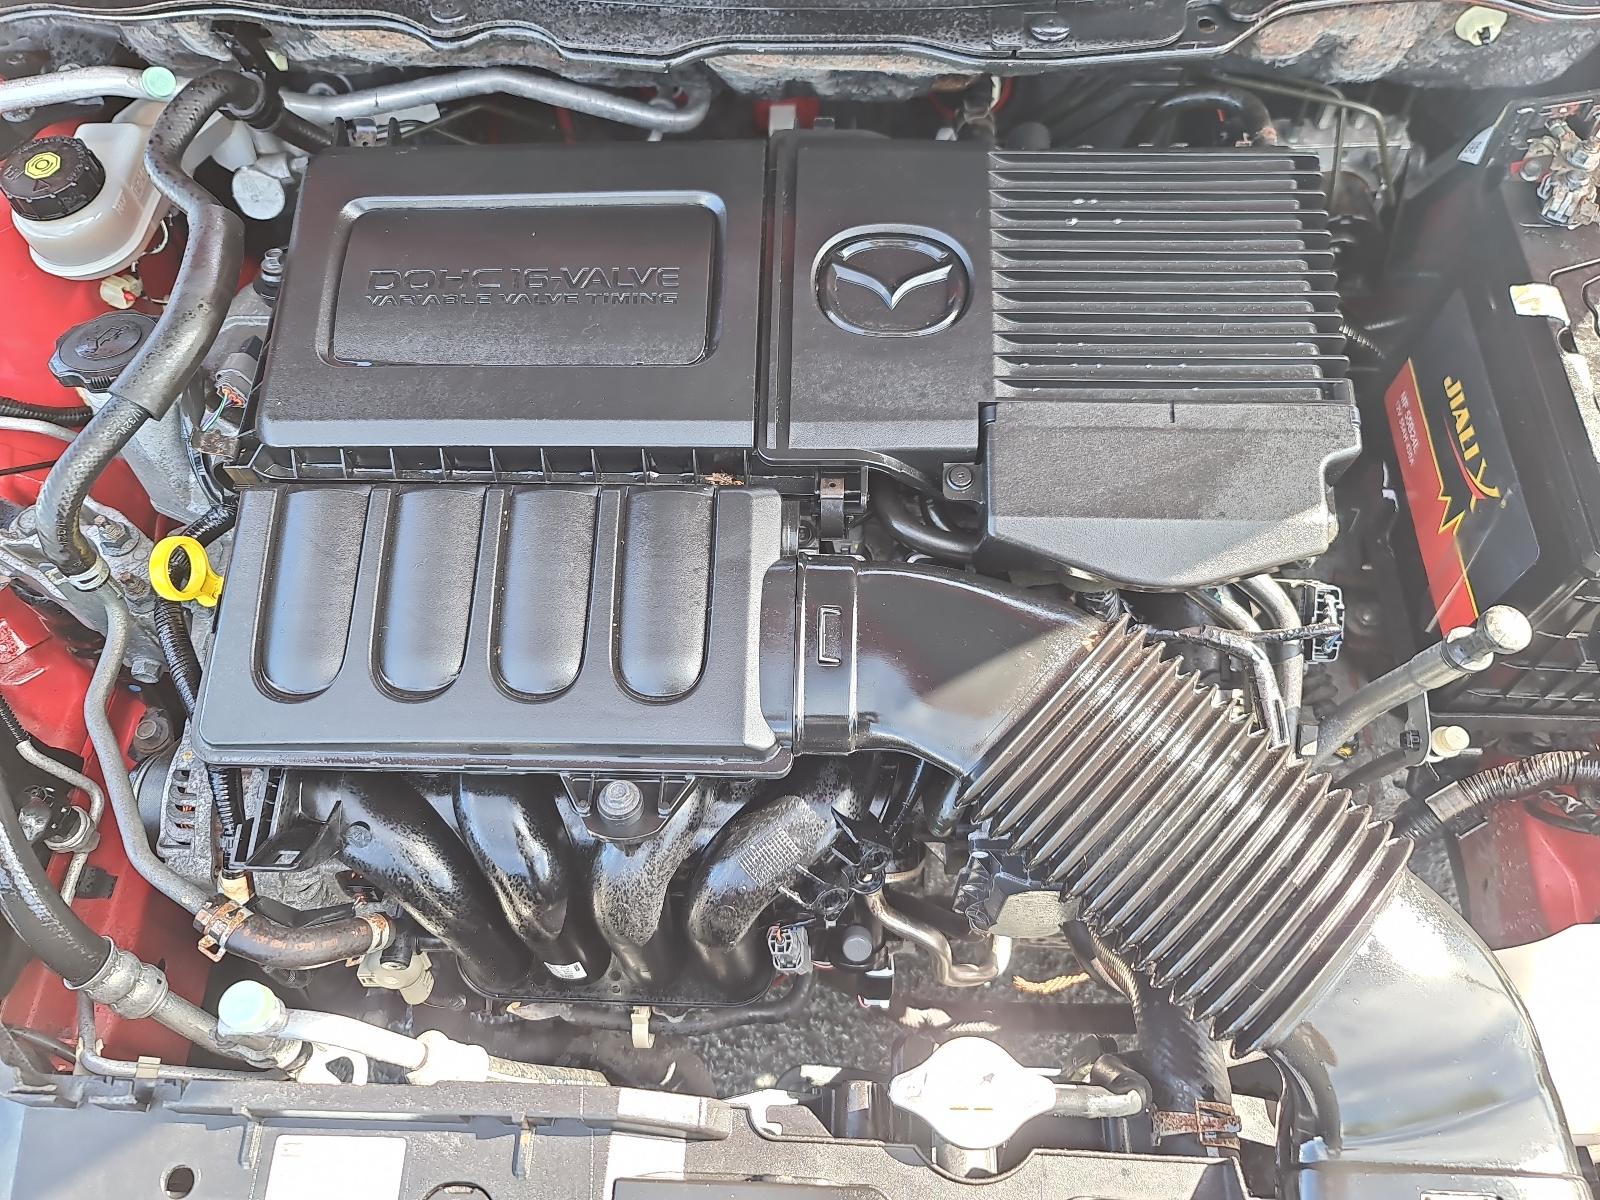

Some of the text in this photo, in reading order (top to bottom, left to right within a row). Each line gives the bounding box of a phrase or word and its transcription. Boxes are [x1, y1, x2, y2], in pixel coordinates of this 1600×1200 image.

[367, 266, 681, 290] DOHC 16-VALVE
[365, 292, 679, 306] VARIABLE VALVE TIMING
